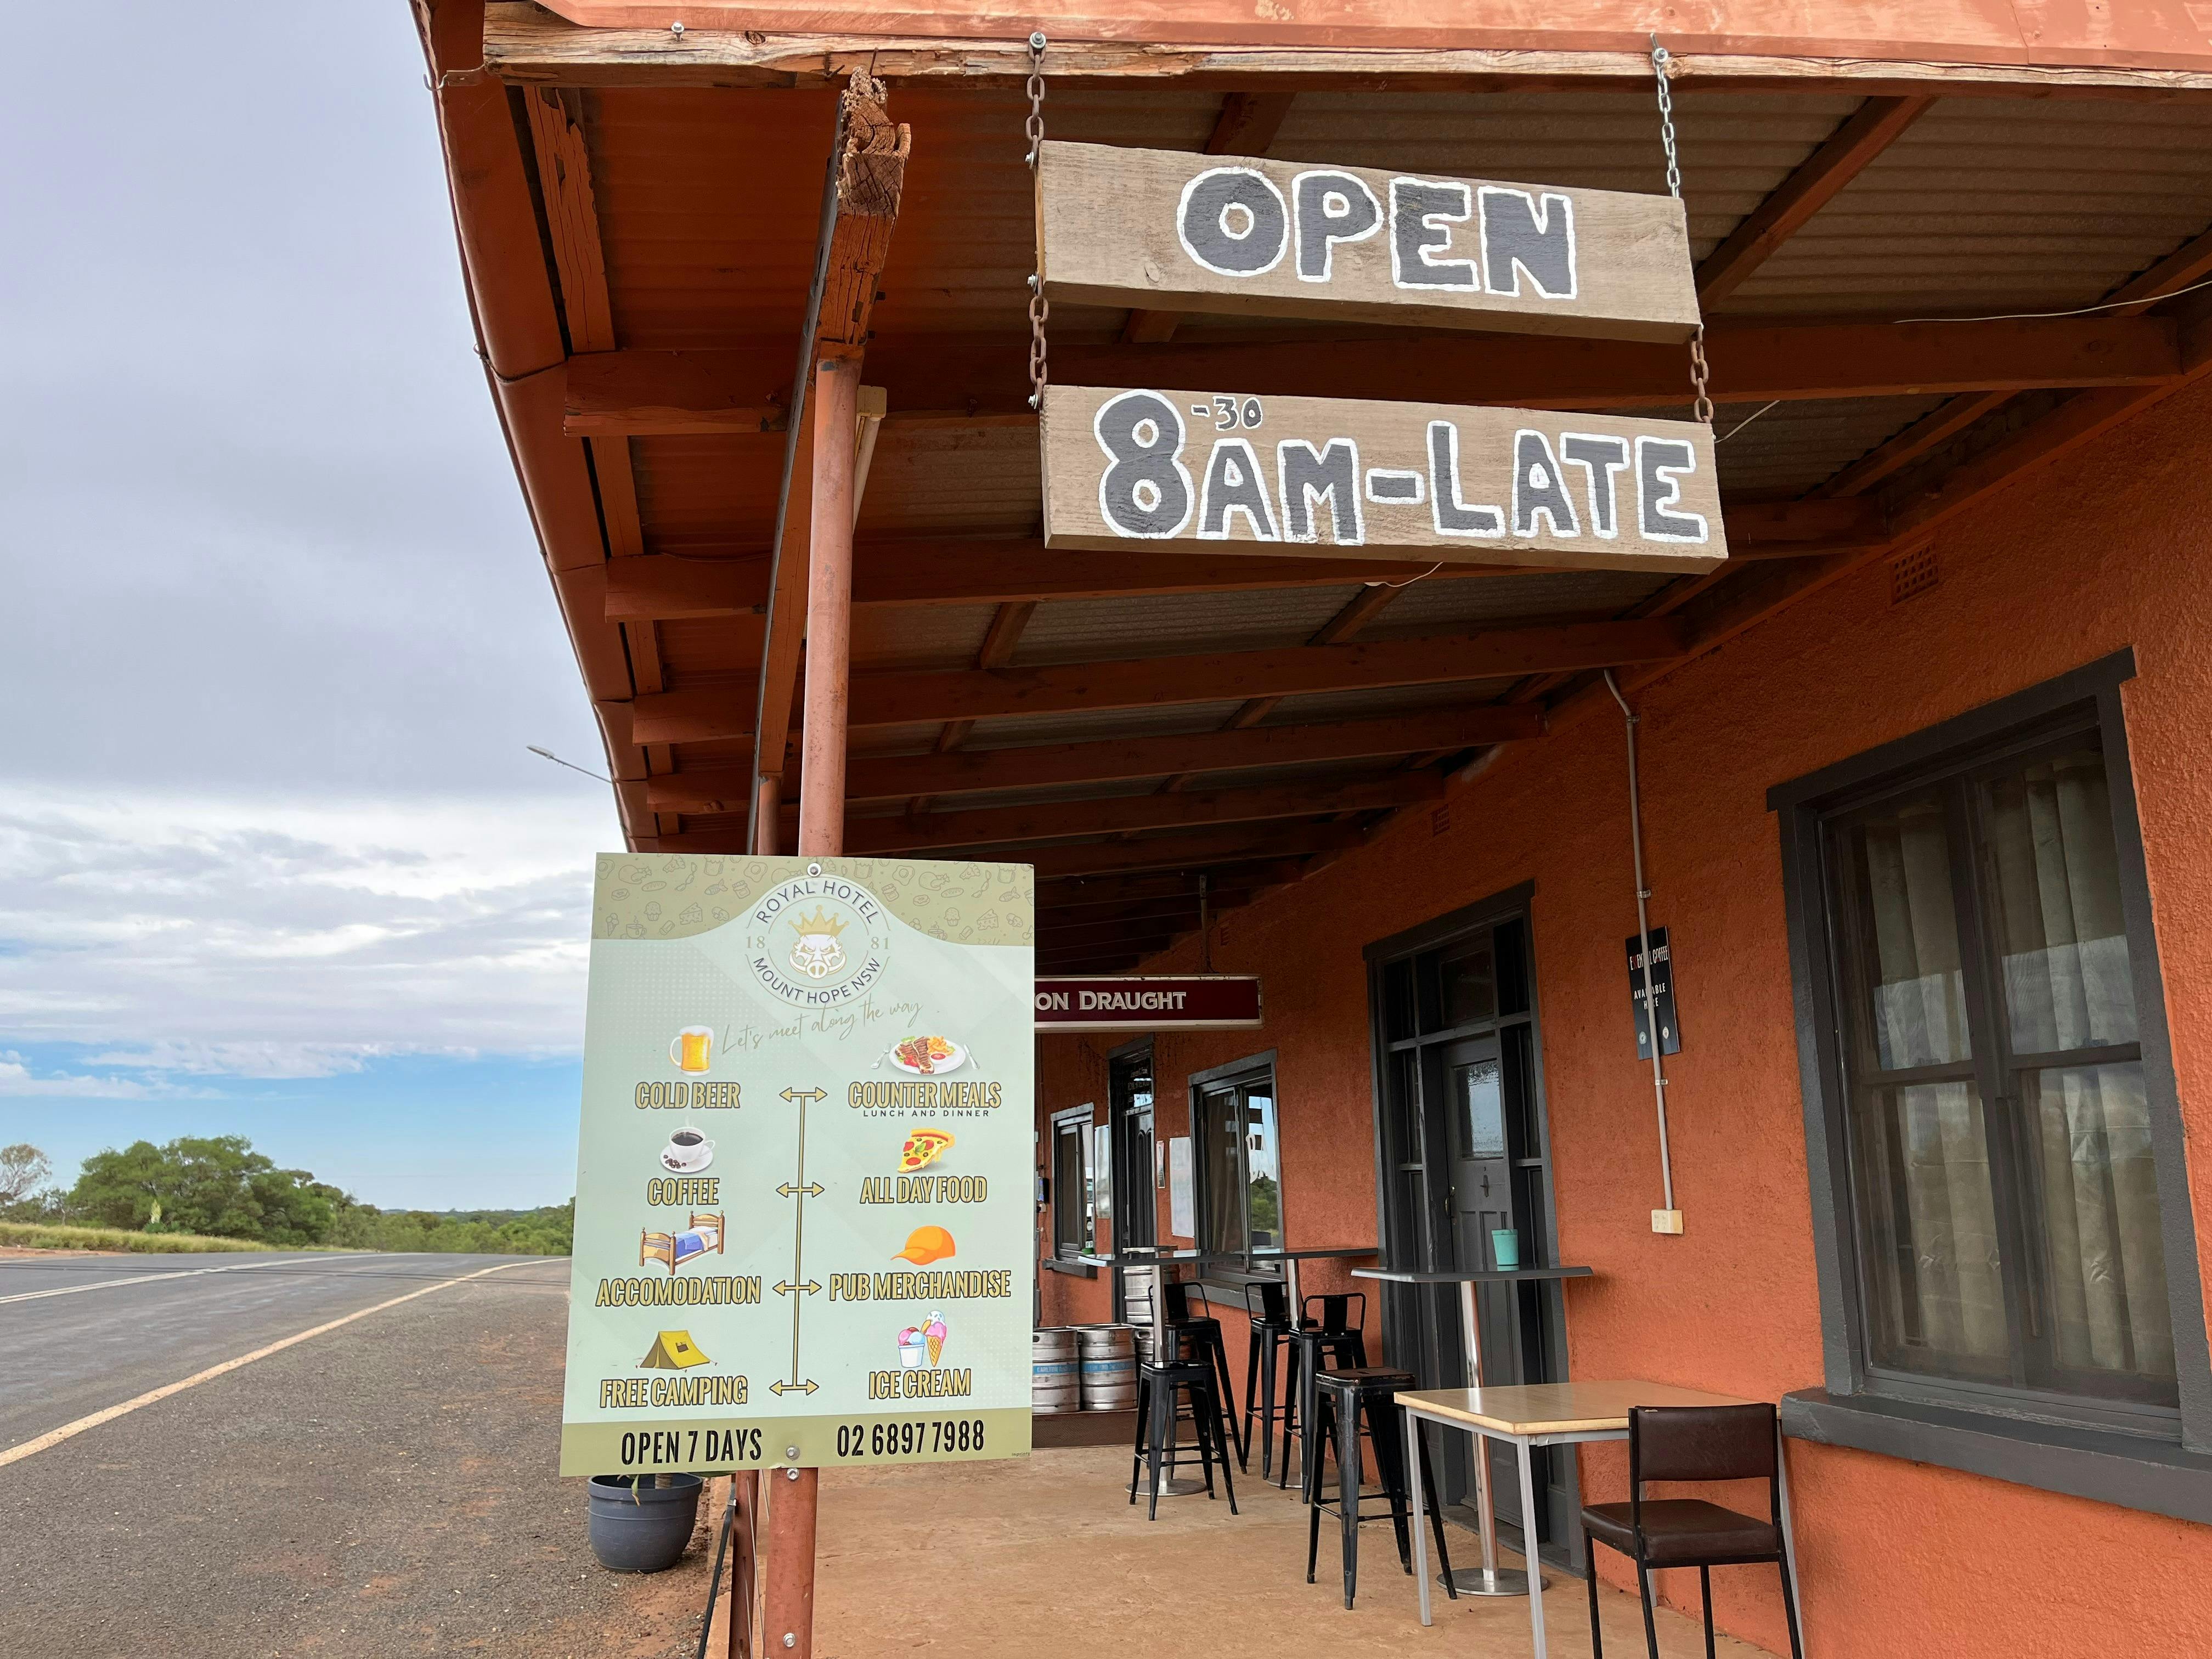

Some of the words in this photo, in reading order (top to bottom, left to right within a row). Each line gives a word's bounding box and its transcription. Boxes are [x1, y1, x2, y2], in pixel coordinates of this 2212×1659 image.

[1177, 166, 1578, 300] OPEN
[756, 881, 815, 923] ROYAL
[823, 880, 878, 924] HOTEL
[746, 935, 765, 949] 18
[871, 936, 890, 950] 81
[1652, 945, 1668, 964] COFFEE
[753, 957, 803, 1001] MOUNT
[807, 985, 851, 1003] HOPE
[851, 957, 880, 991] NSW
[1079, 990, 1187, 1011] DRAUGHT
[721, 1024, 764, 1055] Let's
[769, 1013, 812, 1040] meet
[811, 1003, 859, 1041] along
[859, 992, 884, 1027] the
[890, 1002, 923, 1028] way
[635, 1081, 689, 1109] COLD
[691, 1081, 741, 1109] BEER
[848, 1081, 938, 1109] COUNTER
[939, 1081, 1002, 1109] MEALS
[647, 1177, 720, 1206] COFFEE
[859, 1176, 894, 1204] ALL
[896, 1176, 935, 1204] DAY
[936, 1176, 988, 1203] FOOD
[595, 1276, 761, 1307] ACCOMODATION
[829, 1273, 871, 1301] PUB
[873, 1269, 1012, 1301] MERCHANDISE
[600, 1378, 649, 1409] FREE
[651, 1375, 748, 1407] CAMPING
[868, 1370, 901, 1400] ICE
[902, 1368, 972, 1399] CREAM
[621, 1431, 680, 1465] OPEN
[687, 1430, 698, 1463] 7
[705, 1428, 763, 1462] DAYS
[837, 1425, 865, 1457] 02
[871, 1423, 926, 1455] 6897
[932, 1419, 984, 1453] 7988
